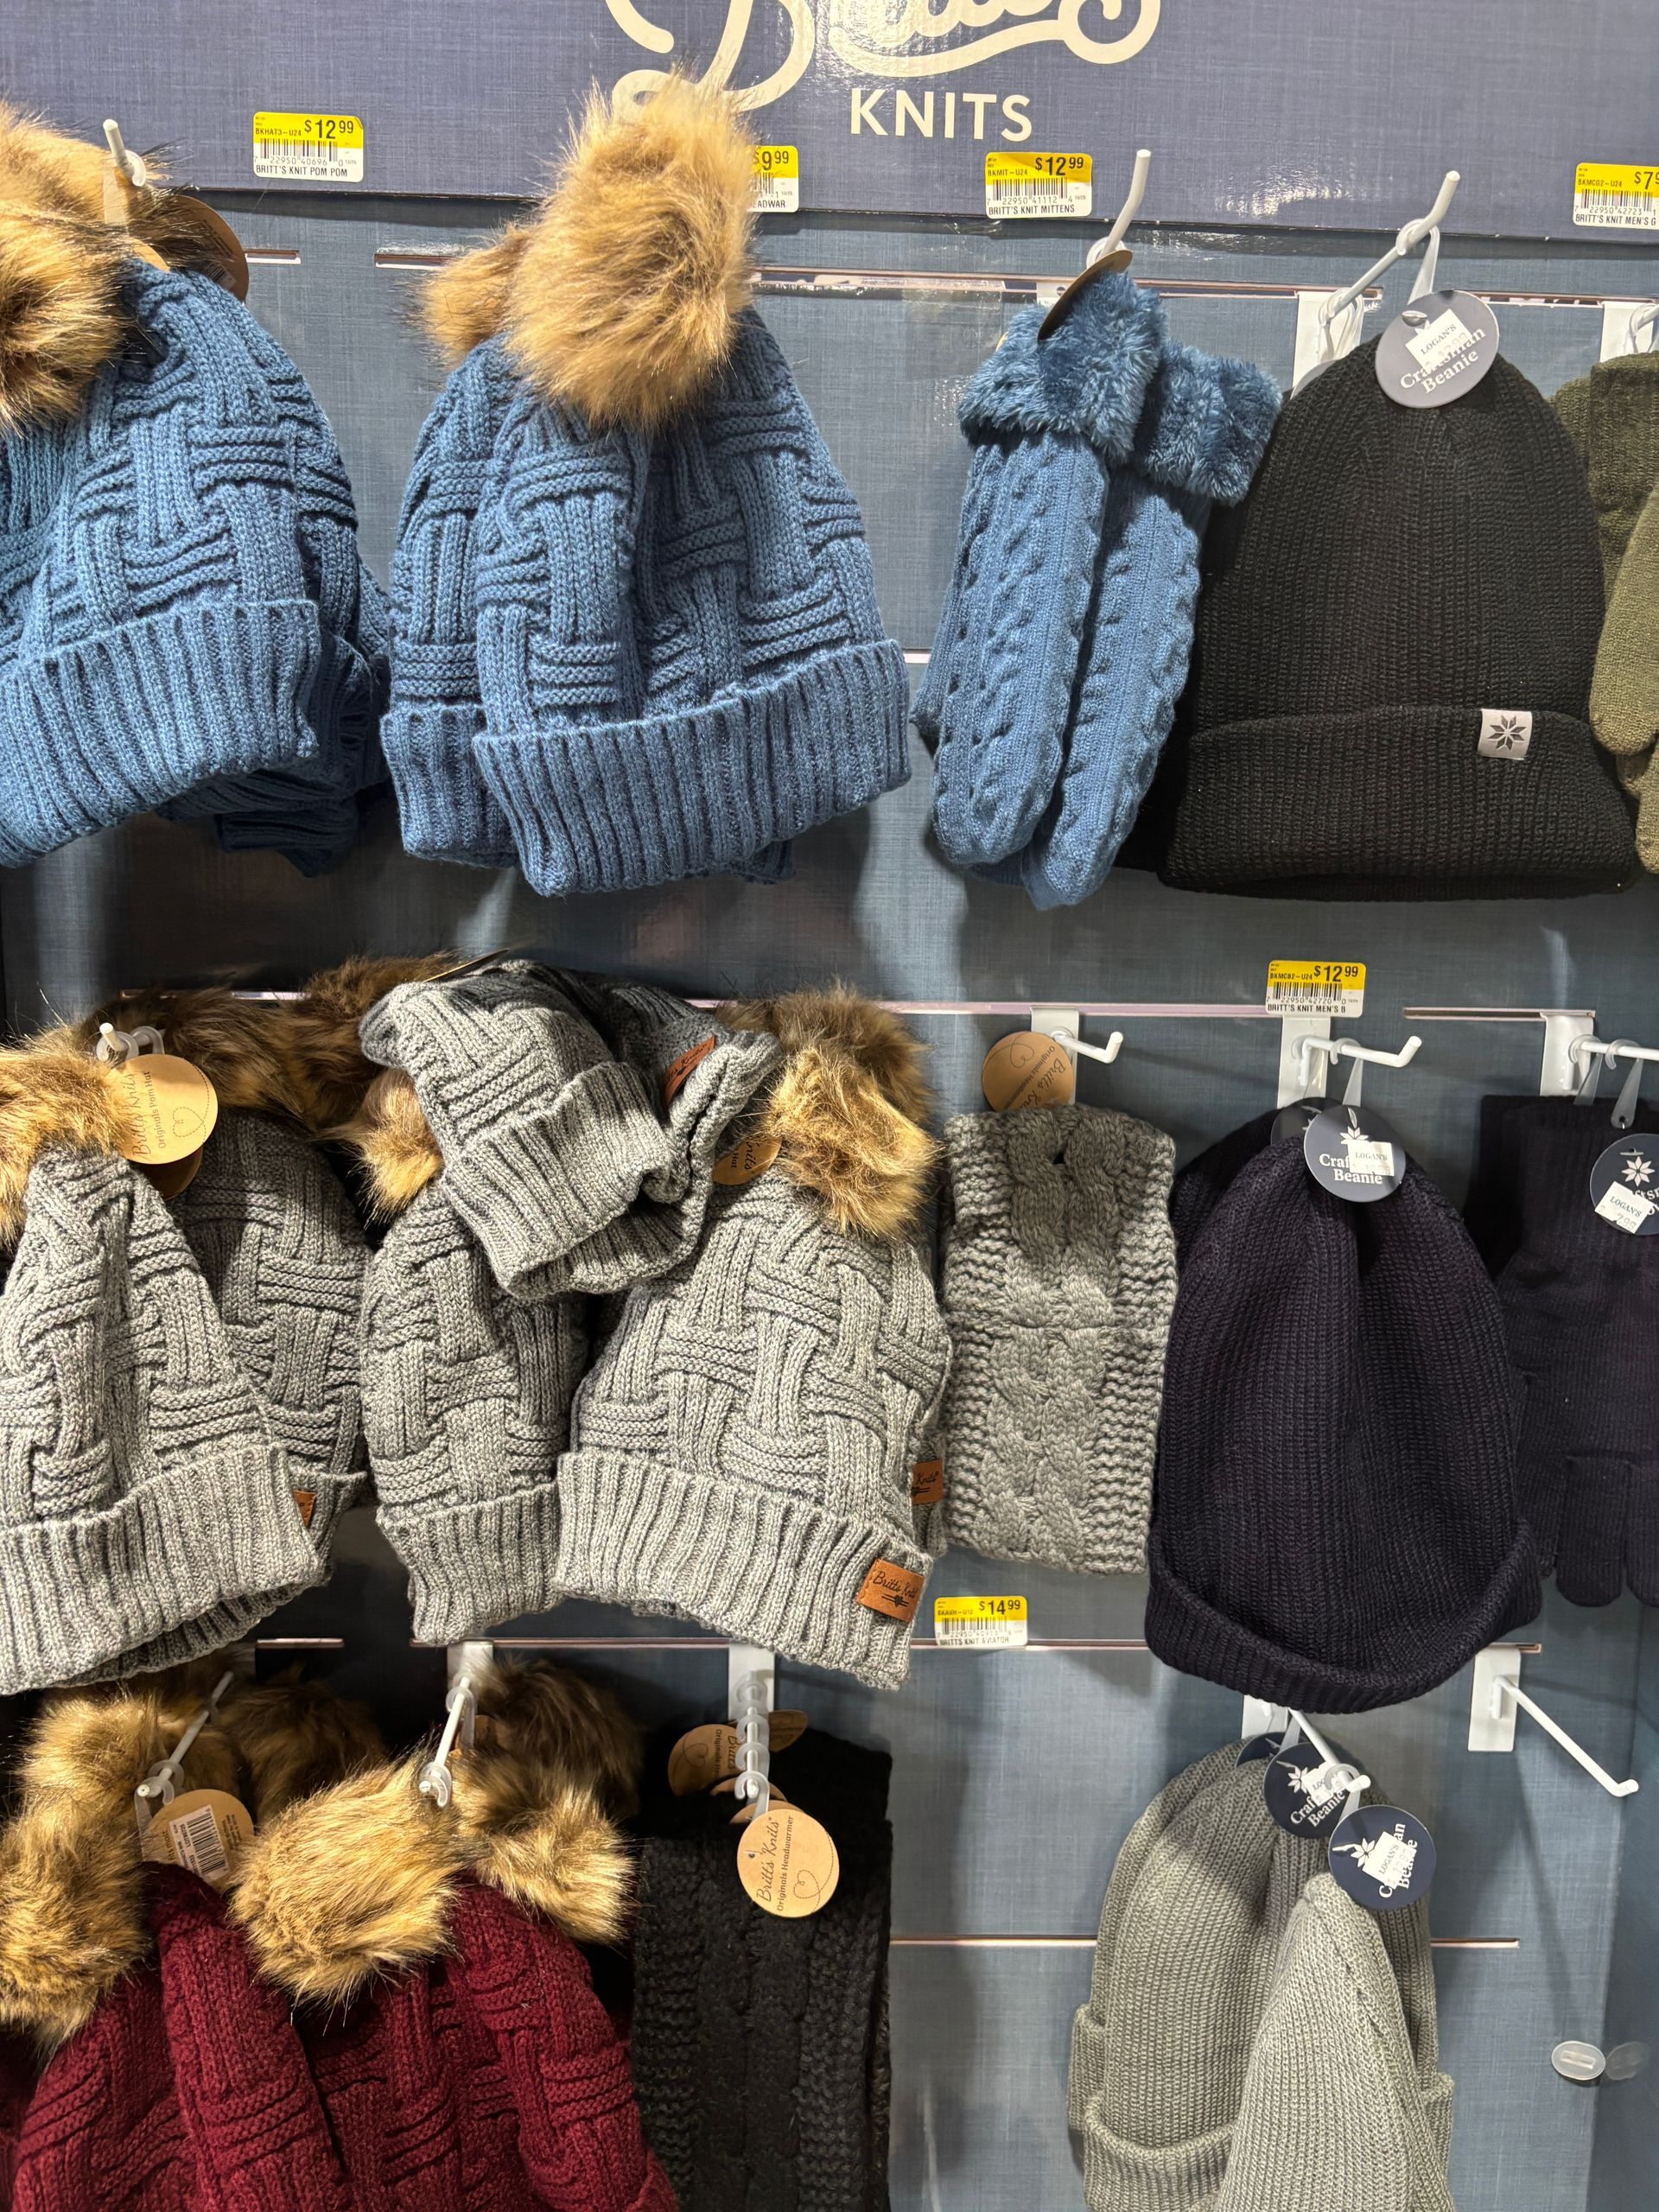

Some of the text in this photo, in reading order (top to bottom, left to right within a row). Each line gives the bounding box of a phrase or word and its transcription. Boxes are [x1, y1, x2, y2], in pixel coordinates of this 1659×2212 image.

[849, 87, 1033, 142] KNITS
[256, 165, 347, 177] BRITT'S KNIT POM POM
[301, 157, 327, 166] 40696
[756, 200, 785, 208] ADWAR
[988, 204, 1075, 215] BRITT'S KNIT MITTENS
[1068, 195, 1073, 204] 4
[1575, 213, 1604, 223] BRITT'S
[1606, 215, 1623, 224] KNIT
[1625, 216, 1649, 226] MEN'S
[1420, 324, 1457, 355] LOGAN'S
[1421, 350, 1478, 394] Beanie
[143, 1071, 166, 1148] Originals Pom Hat
[1333, 1168, 1382, 1185] Beanie
[1610, 1196, 1642, 1217] LOGAN'S
[1307, 1790, 1345, 1827] Beanie
[777, 1816, 794, 1911] Originals Headwarmer
[1378, 1844, 1400, 1874] LOGAN'S
[756, 1859, 775, 1902] Britt's
